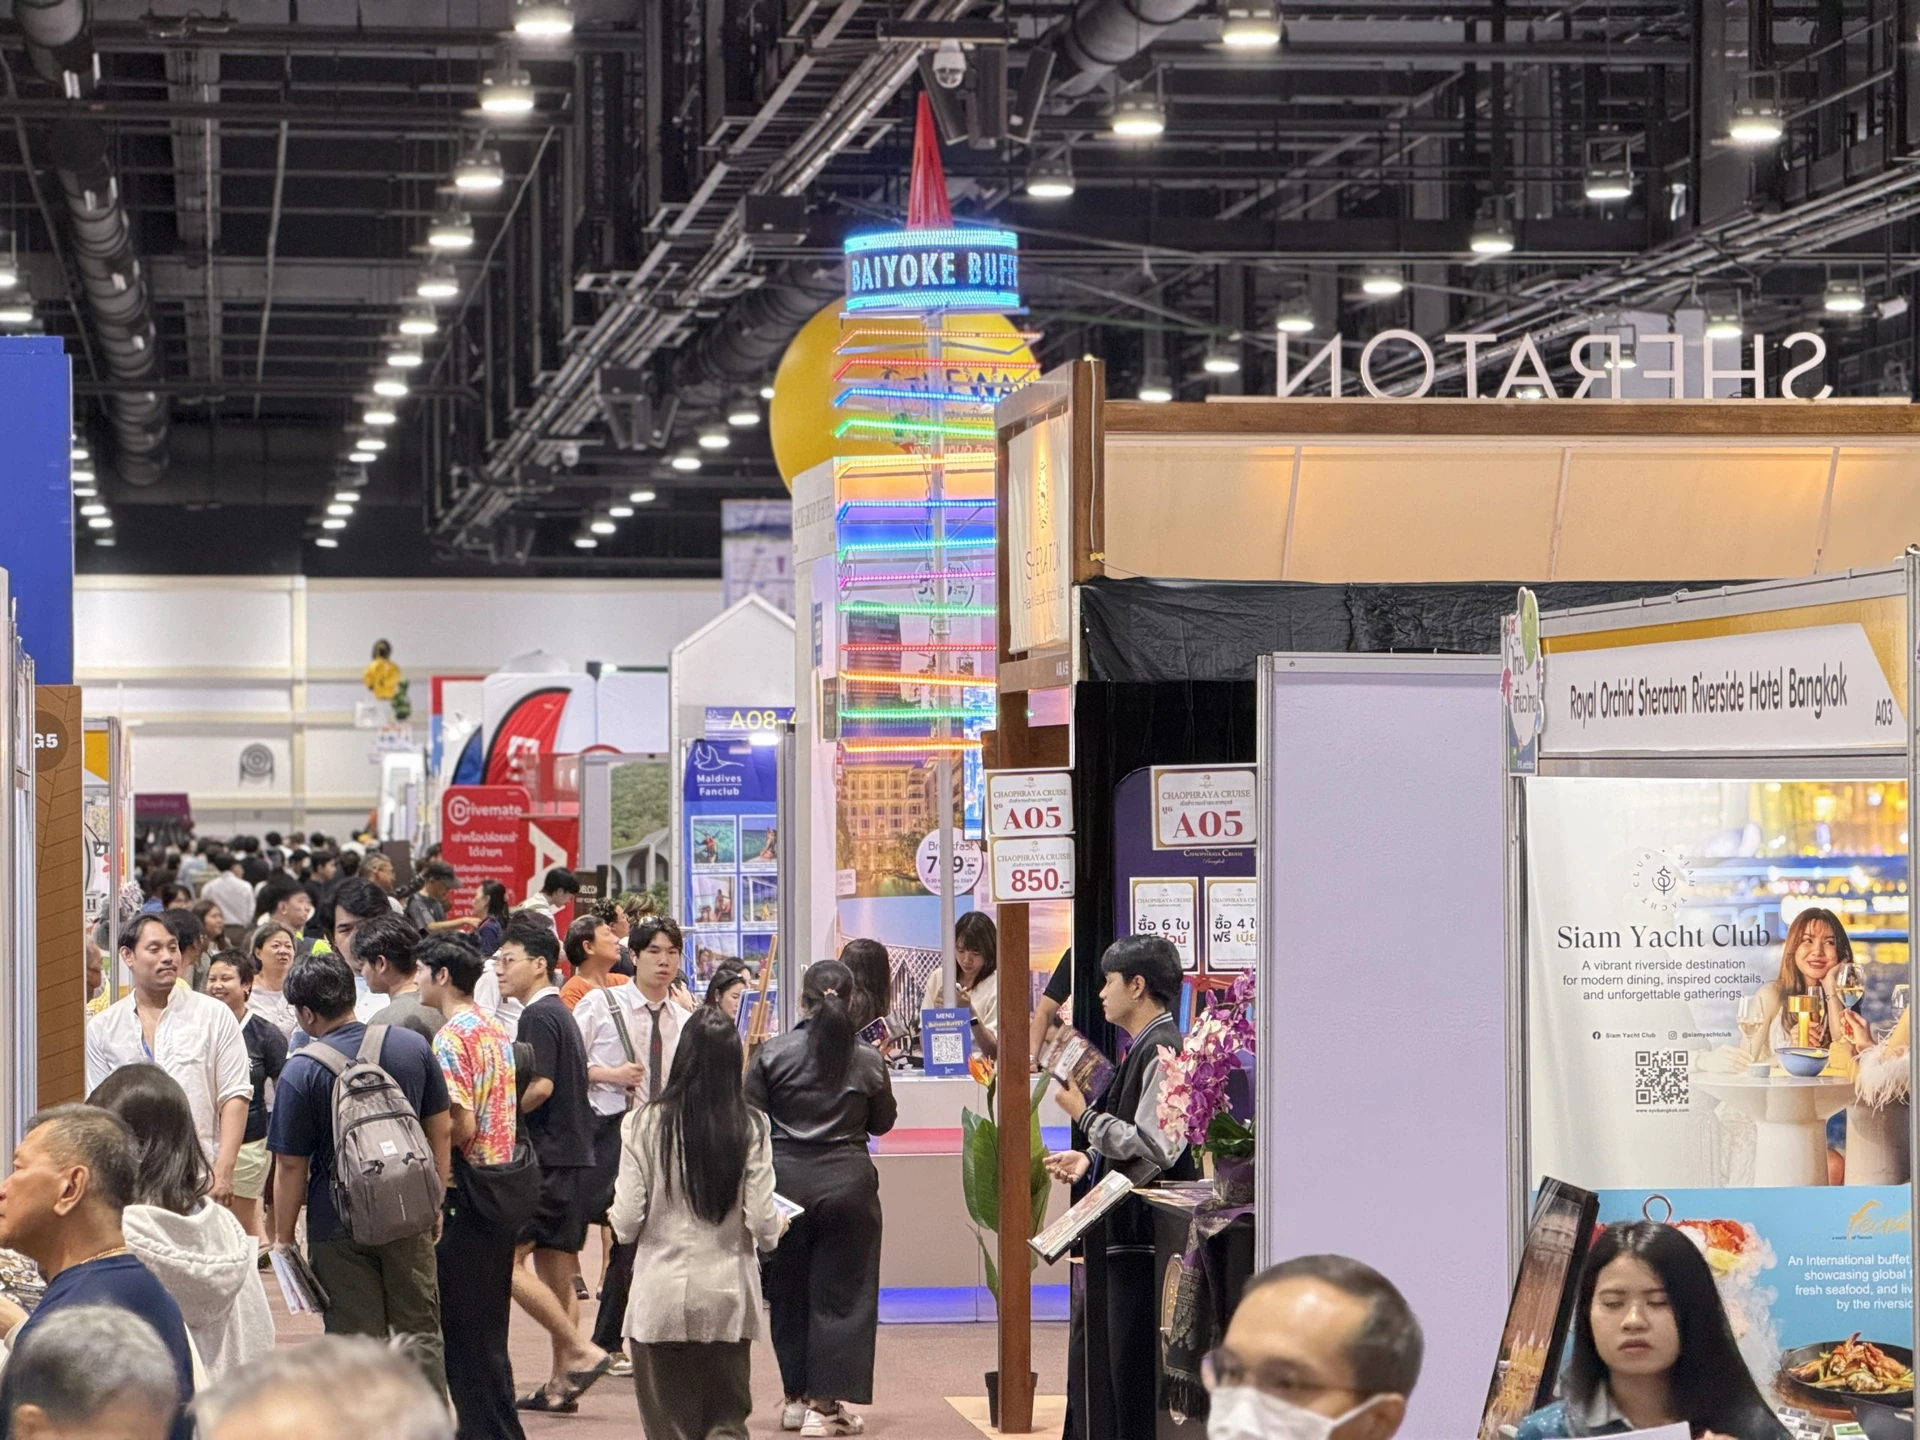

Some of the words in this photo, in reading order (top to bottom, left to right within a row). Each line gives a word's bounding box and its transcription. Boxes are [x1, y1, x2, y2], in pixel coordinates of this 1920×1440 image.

[852, 253, 956, 292] BAIYOKE
[1570, 681, 1596, 730] Royal
[1600, 677, 1634, 719] Orchid
[1638, 676, 1687, 717] Sheraton
[1692, 670, 1744, 714] Riverside
[1750, 665, 1783, 711] Hotel
[1789, 661, 1847, 719] Bangkok
[1875, 699, 1893, 726] A03
[696, 774, 742, 783] Maldives
[699, 787, 740, 796] Fanclub
[993, 789, 1042, 798] CHAOPHRAYA
[1043, 788, 1068, 797] CRUISE
[1162, 790, 1219, 800] CHAOPHRAYA
[1221, 789, 1251, 798] CRUISE
[450, 800, 522, 821] Drivemate
[1003, 806, 1062, 830] A05
[1172, 810, 1243, 839] A05
[996, 854, 1045, 862] CHAOPHRAYA
[1046, 852, 1071, 861] CRUISE
[1633, 853, 1651, 887] CLUB
[1138, 914, 1156, 931] ซื้อ
[1161, 919, 1171, 931] 6
[1176, 918, 1190, 931] ใบ
[1214, 913, 1232, 930] ซื้อ
[1237, 918, 1245, 929] 4
[1213, 930, 1231, 943] ฟรี
[1558, 925, 1621, 949] Siam
[1631, 924, 1705, 948] Yacht
[1712, 923, 1771, 947] Club
[1582, 960, 1591, 970] A
[1593, 960, 1632, 970] vibrant
[1635, 960, 1682, 970] riverside
[1686, 959, 1745, 970] destination
[1563, 975, 1577, 985] for
[1581, 975, 1624, 985] modern
[1627, 975, 1664, 987] dining,
[1667, 974, 1711, 986] inspired
[1714, 973, 1765, 985] cocktails,
[1583, 990, 1604, 1000] and
[1607, 989, 1681, 1001] unforgettable
[1684, 989, 1744, 1001] gatherings.
[1682, 1031, 1732, 1039] @siamyachtclub
[1788, 1255, 1803, 1266] An
[1806, 1254, 1874, 1265] International
[1877, 1253, 1910, 1265] buffet
[1804, 1269, 1869, 1282] showcasing
[1872, 1269, 1906, 1282] global
[1795, 1285, 1822, 1296] fresh
[1825, 1284, 1874, 1296] seafood,
[1876, 1284, 1898, 1294] and
[1836, 1299, 1850, 1312] by
[1853, 1299, 1870, 1309] the
